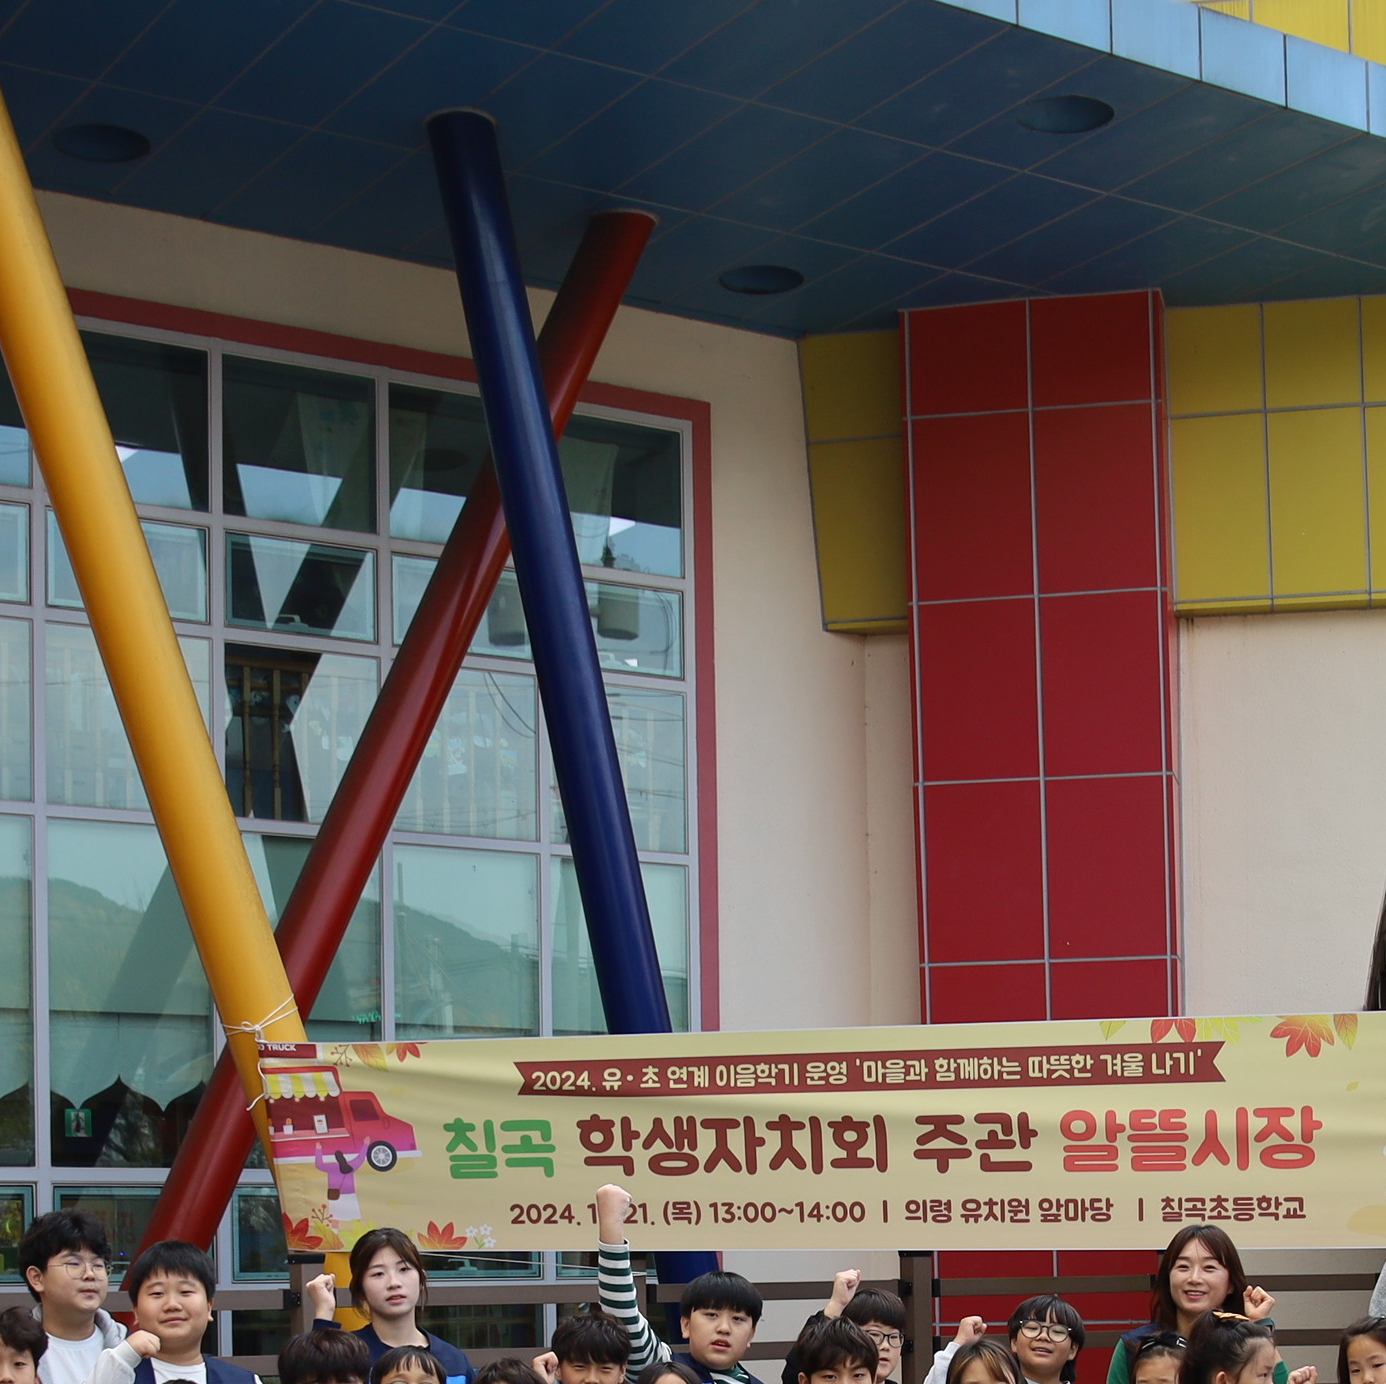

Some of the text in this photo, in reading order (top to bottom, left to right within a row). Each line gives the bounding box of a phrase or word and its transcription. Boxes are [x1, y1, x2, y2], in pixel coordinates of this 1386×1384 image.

[266, 1043, 297, 1052] TRUCK
[530, 1070, 597, 1092] 2024.
[667, 1064, 710, 1089] 연계
[715, 1062, 799, 1088] 이음학기
[805, 1061, 848, 1086] 운영
[855, 1057, 929, 1084] '마을과
[934, 1056, 1022, 1082] 함께하는
[1028, 1053, 1094, 1080] 따뜻한
[1099, 1052, 1144, 1077] 겨울
[442, 1104, 1324, 1180] 칠곡 학생자치회 주관 알뜰시장
[509, 1203, 582, 1226] 2024.
[663, 1199, 703, 1226] (목)
[708, 1200, 866, 1225] 13:00~14:00
[904, 1198, 953, 1224] 의령
[959, 1197, 1031, 1224] 유치원
[1038, 1197, 1114, 1224] 앞마당
[1160, 1195, 1307, 1222] 칠곡초등학교
